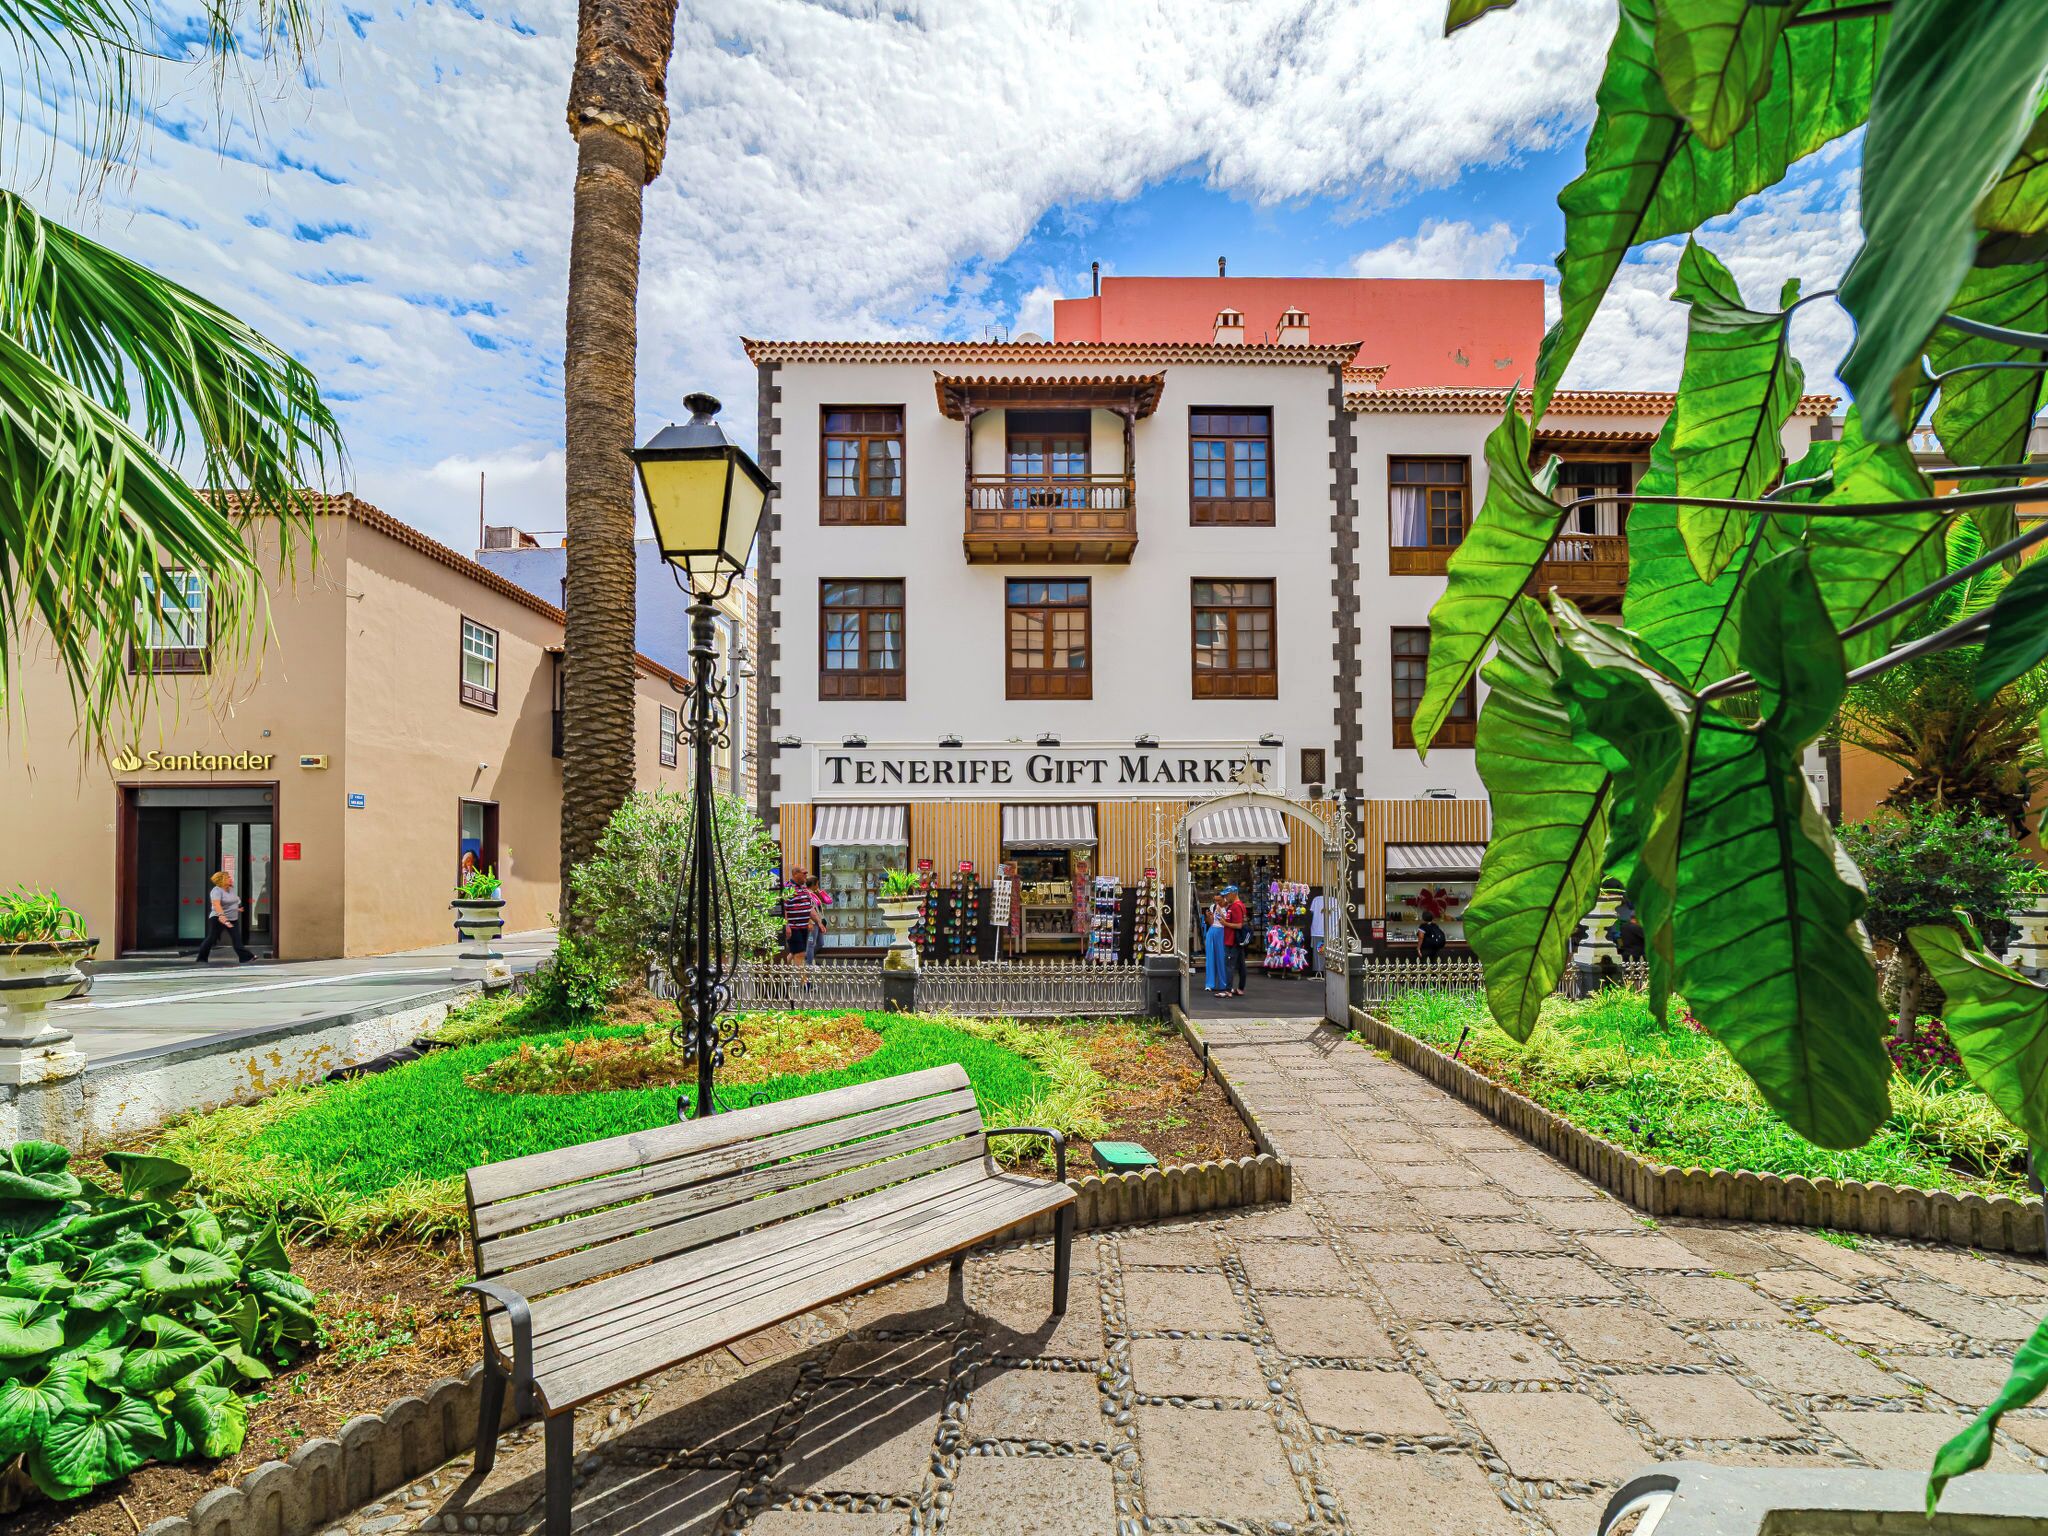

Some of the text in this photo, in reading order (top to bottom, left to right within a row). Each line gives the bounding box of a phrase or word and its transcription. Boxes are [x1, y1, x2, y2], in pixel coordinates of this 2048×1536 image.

[146, 750, 275, 771] Santander
[825, 756, 1013, 784] TENERIFE
[1025, 754, 1108, 784] GIFT
